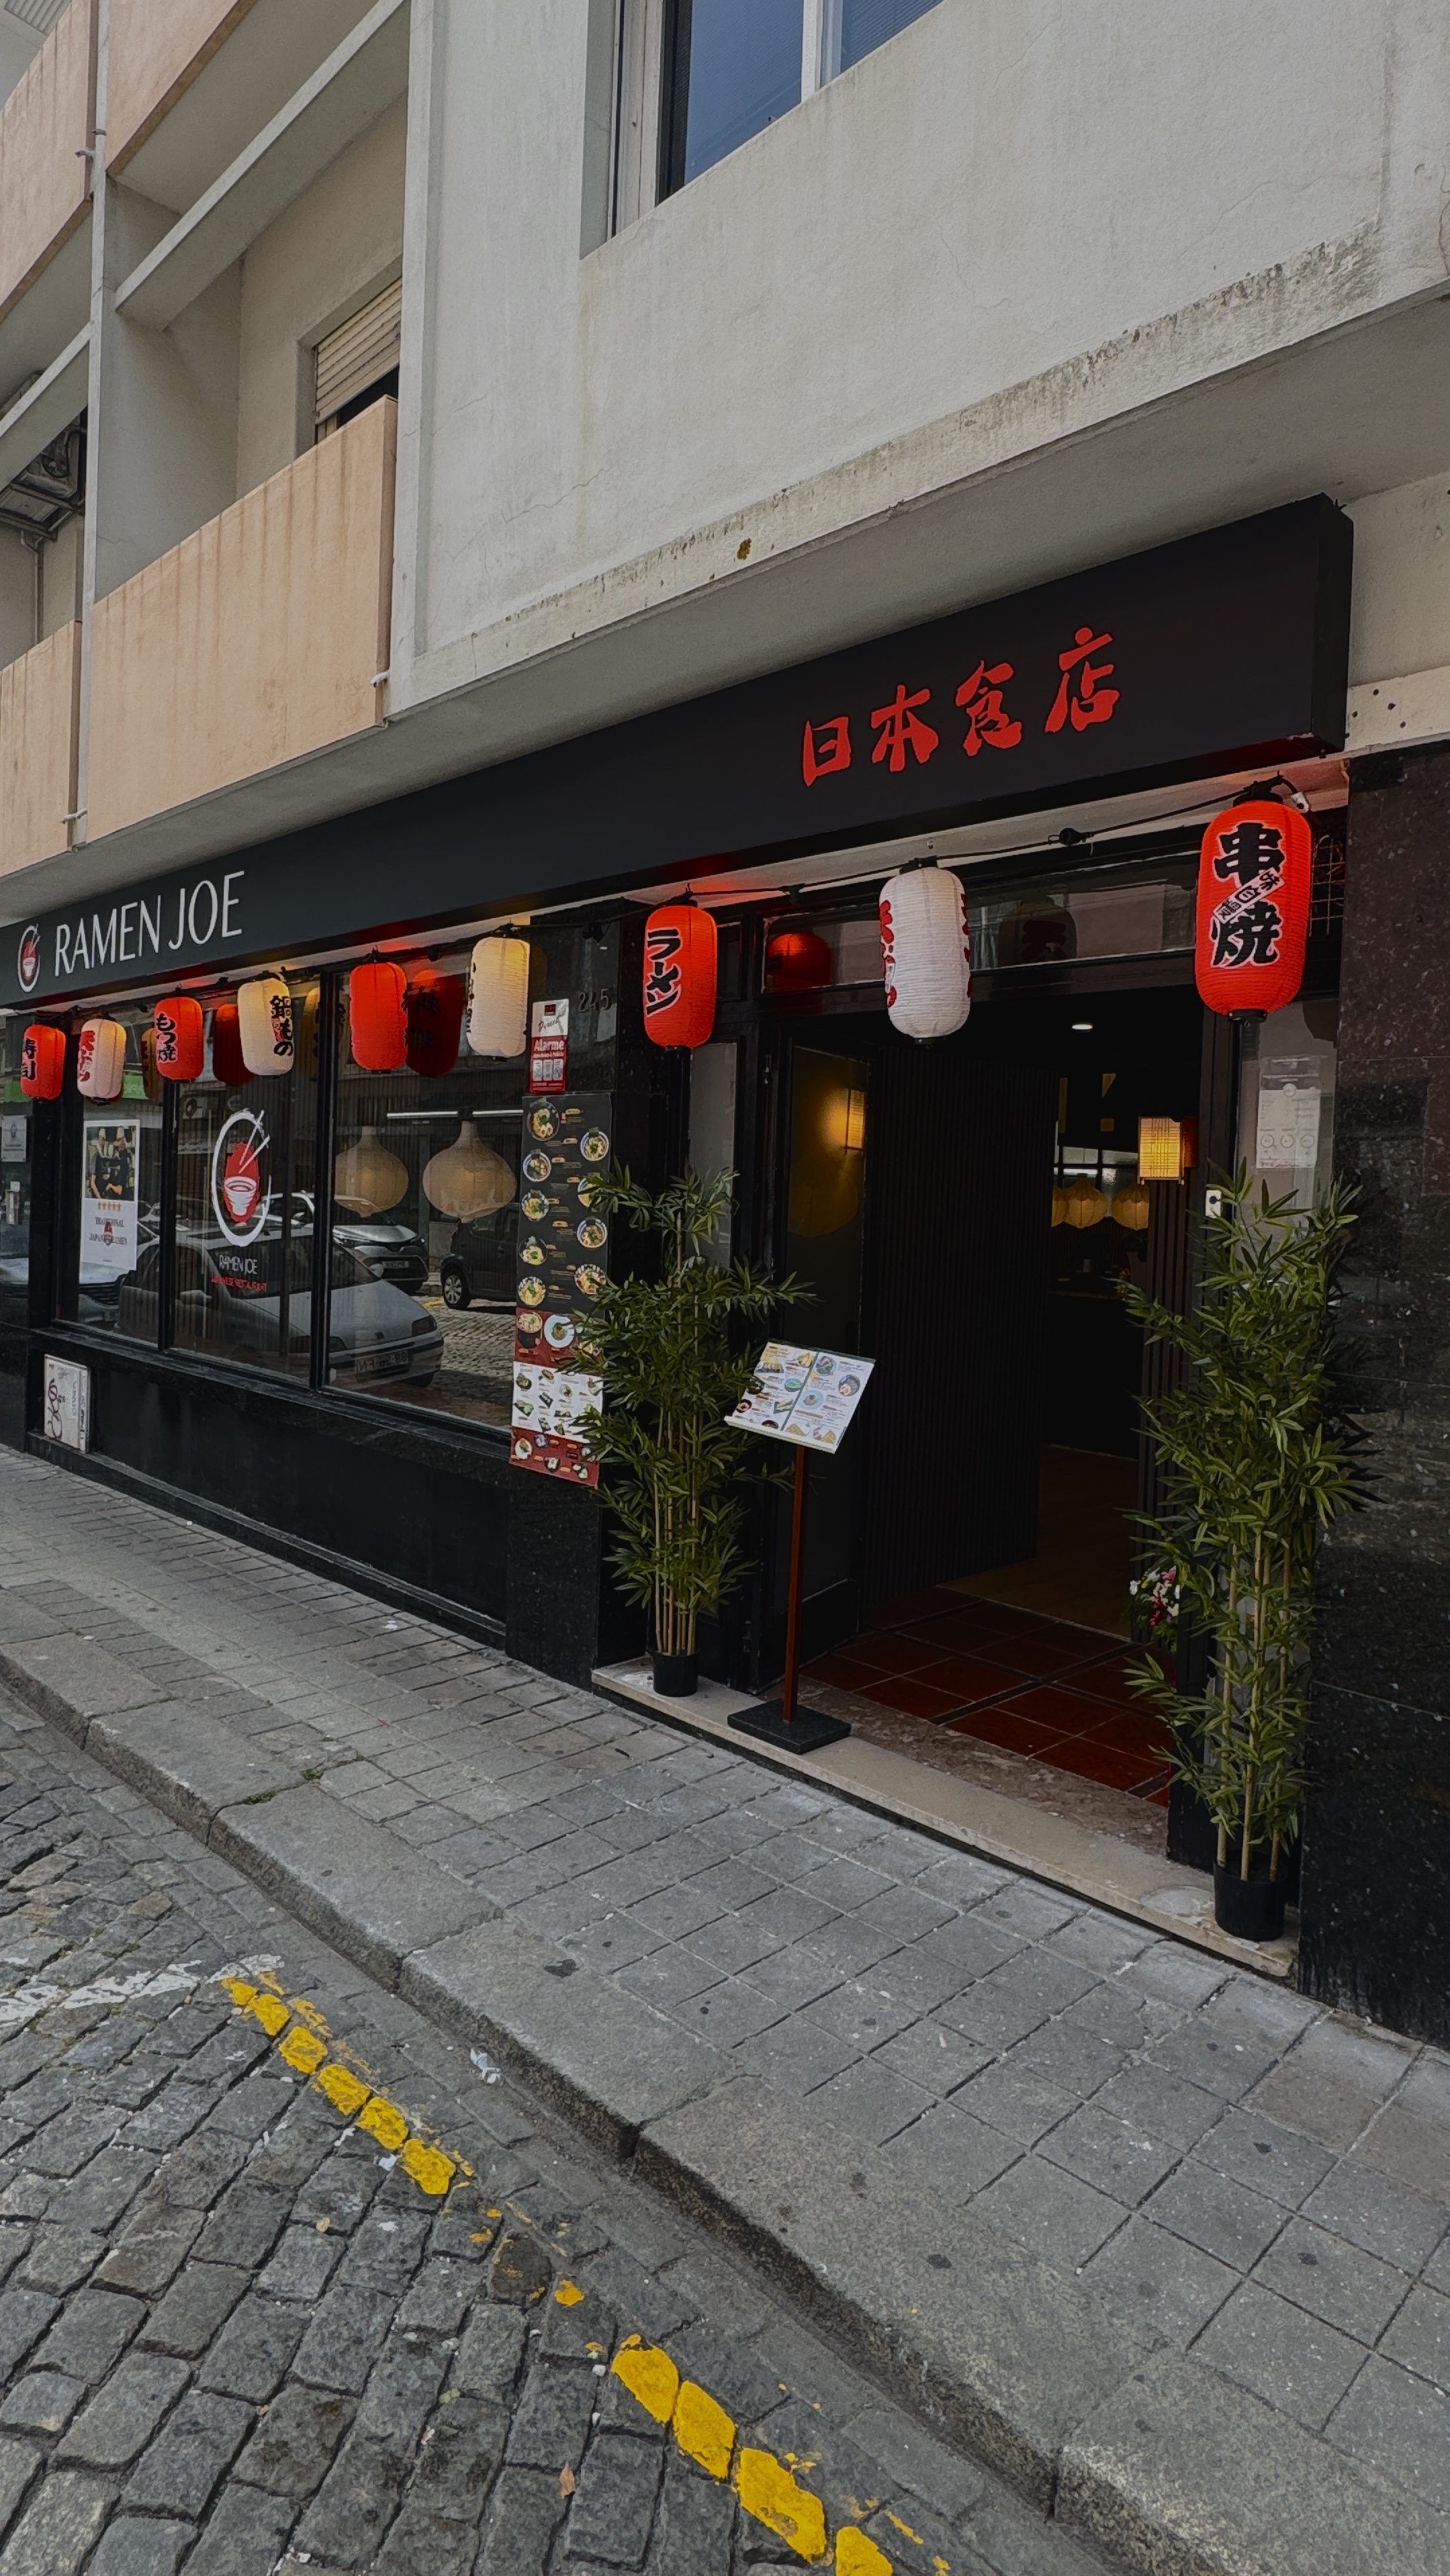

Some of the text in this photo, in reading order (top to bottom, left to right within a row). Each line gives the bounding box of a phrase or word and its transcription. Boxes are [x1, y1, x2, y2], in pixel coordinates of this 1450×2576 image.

[802, 627, 1120, 786] 日本食店
[54, 870, 244, 976] RAMEN JOE
[646, 928, 682, 1016] ラーメン
[219, 1254, 258, 1275] RAMEN JOE
